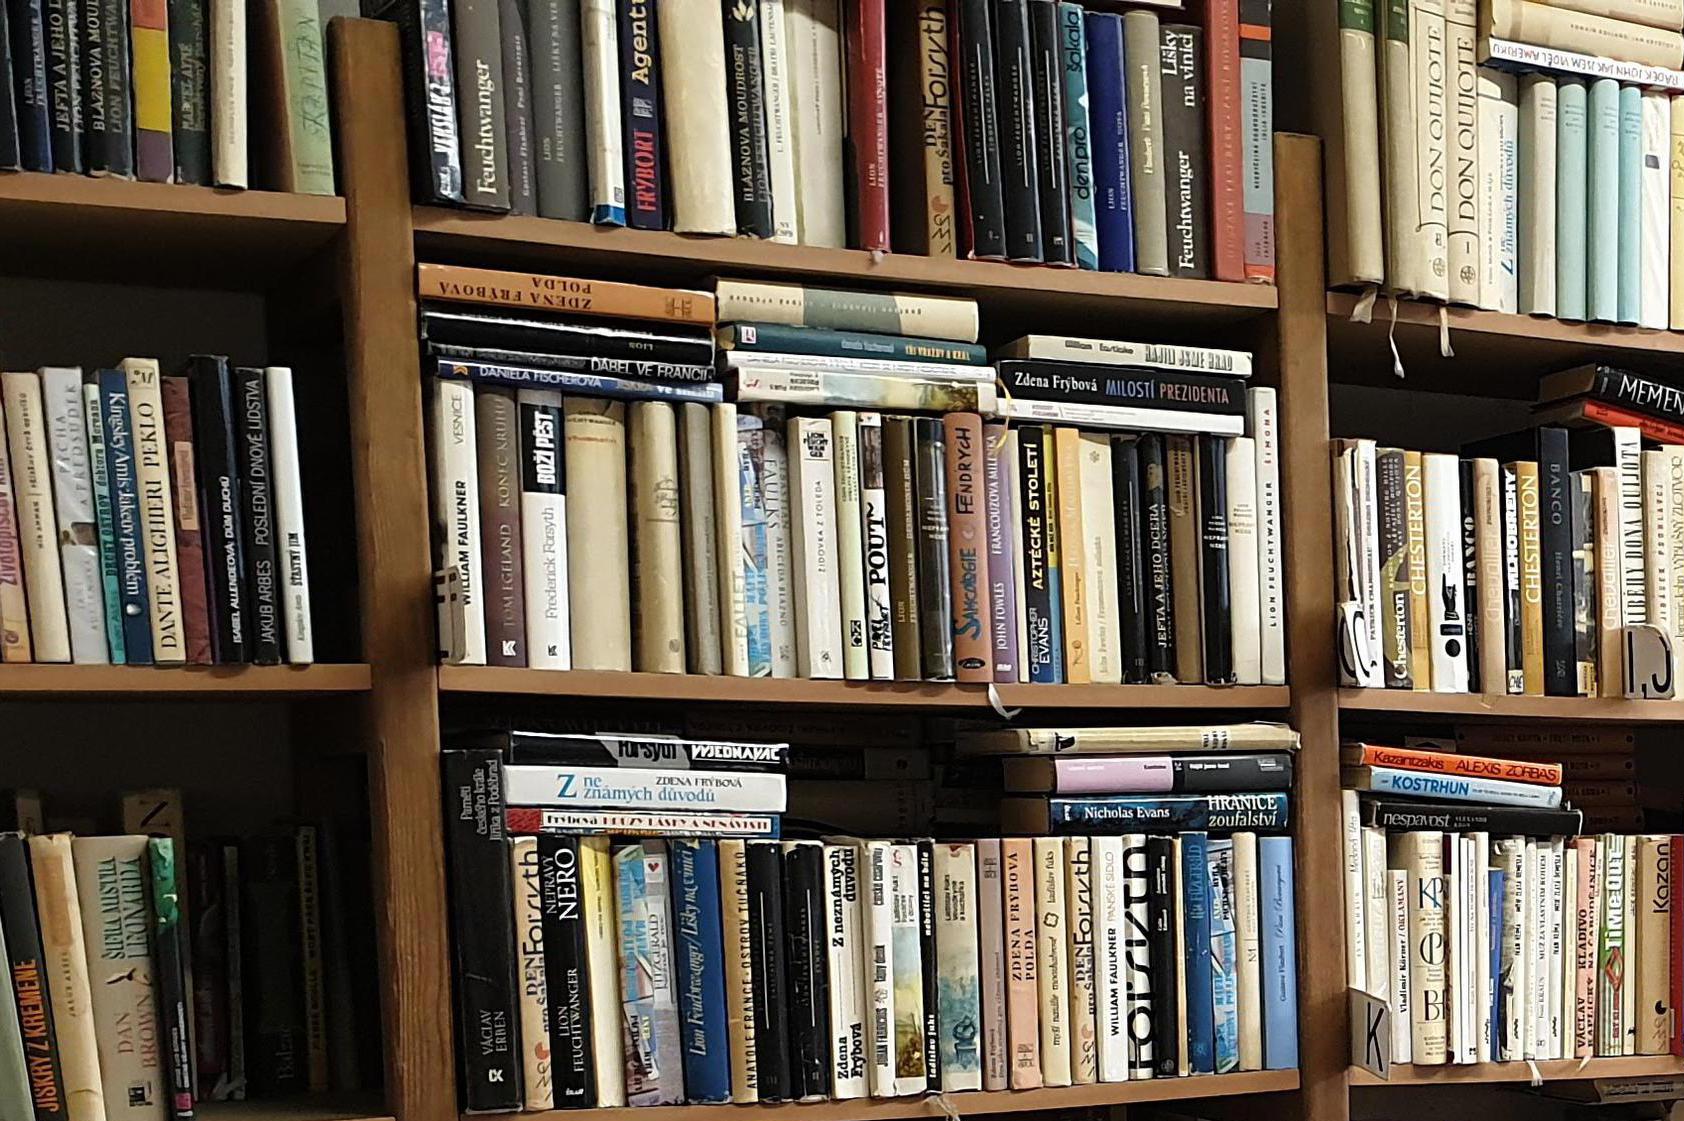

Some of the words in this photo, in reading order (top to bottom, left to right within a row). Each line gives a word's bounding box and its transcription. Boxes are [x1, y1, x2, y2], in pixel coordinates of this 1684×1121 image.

[49, 13, 67, 60] JEHO
[919, 7, 948, 111] Forsyth
[1063, 11, 1083, 73] šakala
[1160, 29, 1179, 76] Lišky
[53, 80, 70, 132] JEFTA
[732, 44, 748, 124] MOUDROST
[1184, 85, 1196, 108] na
[1427, 25, 1444, 142] QUIJOTE
[1456, 36, 1476, 151] QUIJOTE
[475, 58, 497, 194] Feuchtwanger
[1429, 148, 1444, 212] DON
[1458, 157, 1475, 221] DON
[1176, 150, 1194, 269] Feuchtwanger
[438, 281, 522, 305] FRÝBOVÁ
[529, 291, 592, 310] ZDENA
[530, 276, 592, 296] POLDA
[657, 365, 709, 381] FRANCII
[1014, 371, 1050, 389] Zdena
[1053, 375, 1099, 393] Frýbová
[1105, 379, 1154, 399] MILOSTÍ
[1159, 383, 1231, 404] PREZIDENTA
[107, 392, 128, 451] Kingsley
[245, 379, 262, 430] LIDSTVA
[450, 394, 465, 446] VESNICE
[532, 410, 555, 448] PĚST
[137, 403, 161, 469] PEKLO
[534, 447, 556, 485] BOŽÍ
[1023, 442, 1040, 511] STOLETÍ
[250, 479, 269, 546] POSLEDNÍ
[455, 480, 469, 547] FAULKNER
[1552, 463, 1562, 525] BANCO
[144, 479, 172, 580] ALIGHIERI
[539, 507, 556, 554] Forsyth
[1027, 516, 1045, 591] AZTÉCKÉ
[1264, 482, 1275, 590] FEUCHTWANGER
[1405, 464, 1428, 596] CHESTERTON
[1521, 474, 1542, 604] CHESTERTON
[1622, 518, 1643, 560] DONA
[255, 559, 273, 600] ARBES
[541, 558, 558, 620] Frederick
[993, 582, 1006, 620] FOWLES
[155, 583, 177, 648] DANTE
[258, 601, 276, 644] JAKUB
[995, 622, 1009, 650] JOHN
[1268, 594, 1277, 628] LION
[1393, 593, 1409, 679] Chesterton
[1039, 617, 1051, 664] EVANS
[556, 773, 578, 799] Z
[583, 775, 602, 788] ne
[655, 775, 692, 787] ZDENA
[694, 775, 743, 789] FRÝBOVÁ
[1373, 751, 1445, 771] Kazantzakis
[1455, 758, 1502, 776] ALEXIS
[1504, 761, 1557, 781] ZORBAS
[1391, 775, 1469, 796] KOSTRHUN
[582, 785, 653, 805] známých
[657, 785, 716, 803] důvodů
[1083, 806, 1134, 820] Nicholas
[1136, 807, 1170, 819] Evans
[1207, 795, 1277, 811] HRANICE
[1207, 811, 1277, 827] zoufalství
[1383, 812, 1452, 831] nespavost
[554, 848, 580, 921] NERO
[1008, 852, 1021, 923] FRÝBOVÁ
[1653, 842, 1670, 914] Kazan
[119, 855, 148, 959] LEONARDA
[739, 918, 751, 970] OSTROV
[1010, 929, 1024, 983] ZDENA
[1023, 929, 1036, 982] POLDA
[1106, 927, 1118, 985] FAULKNER
[1576, 909, 1588, 970] KLADIVO
[135, 993, 158, 1069] BROWN
[557, 1006, 570, 1038] LION
[566, 968, 586, 1073] FEUCHTWANGER
[739, 979, 754, 1031] FRANCE
[1108, 988, 1120, 1037] WILLIAM
[114, 1011, 134, 1054] DAN
[478, 1010, 494, 1057] VÁCLAV
[492, 1010, 508, 1053] ERBEN
[688, 1029, 708, 1057] Lion
[849, 1021, 863, 1079] Frýbová
[1366, 1000, 1385, 1072] K
[745, 1030, 757, 1090] ANATOLE
[837, 1036, 848, 1080] Zdena
[29, 1058, 60, 1112] JISKRY
